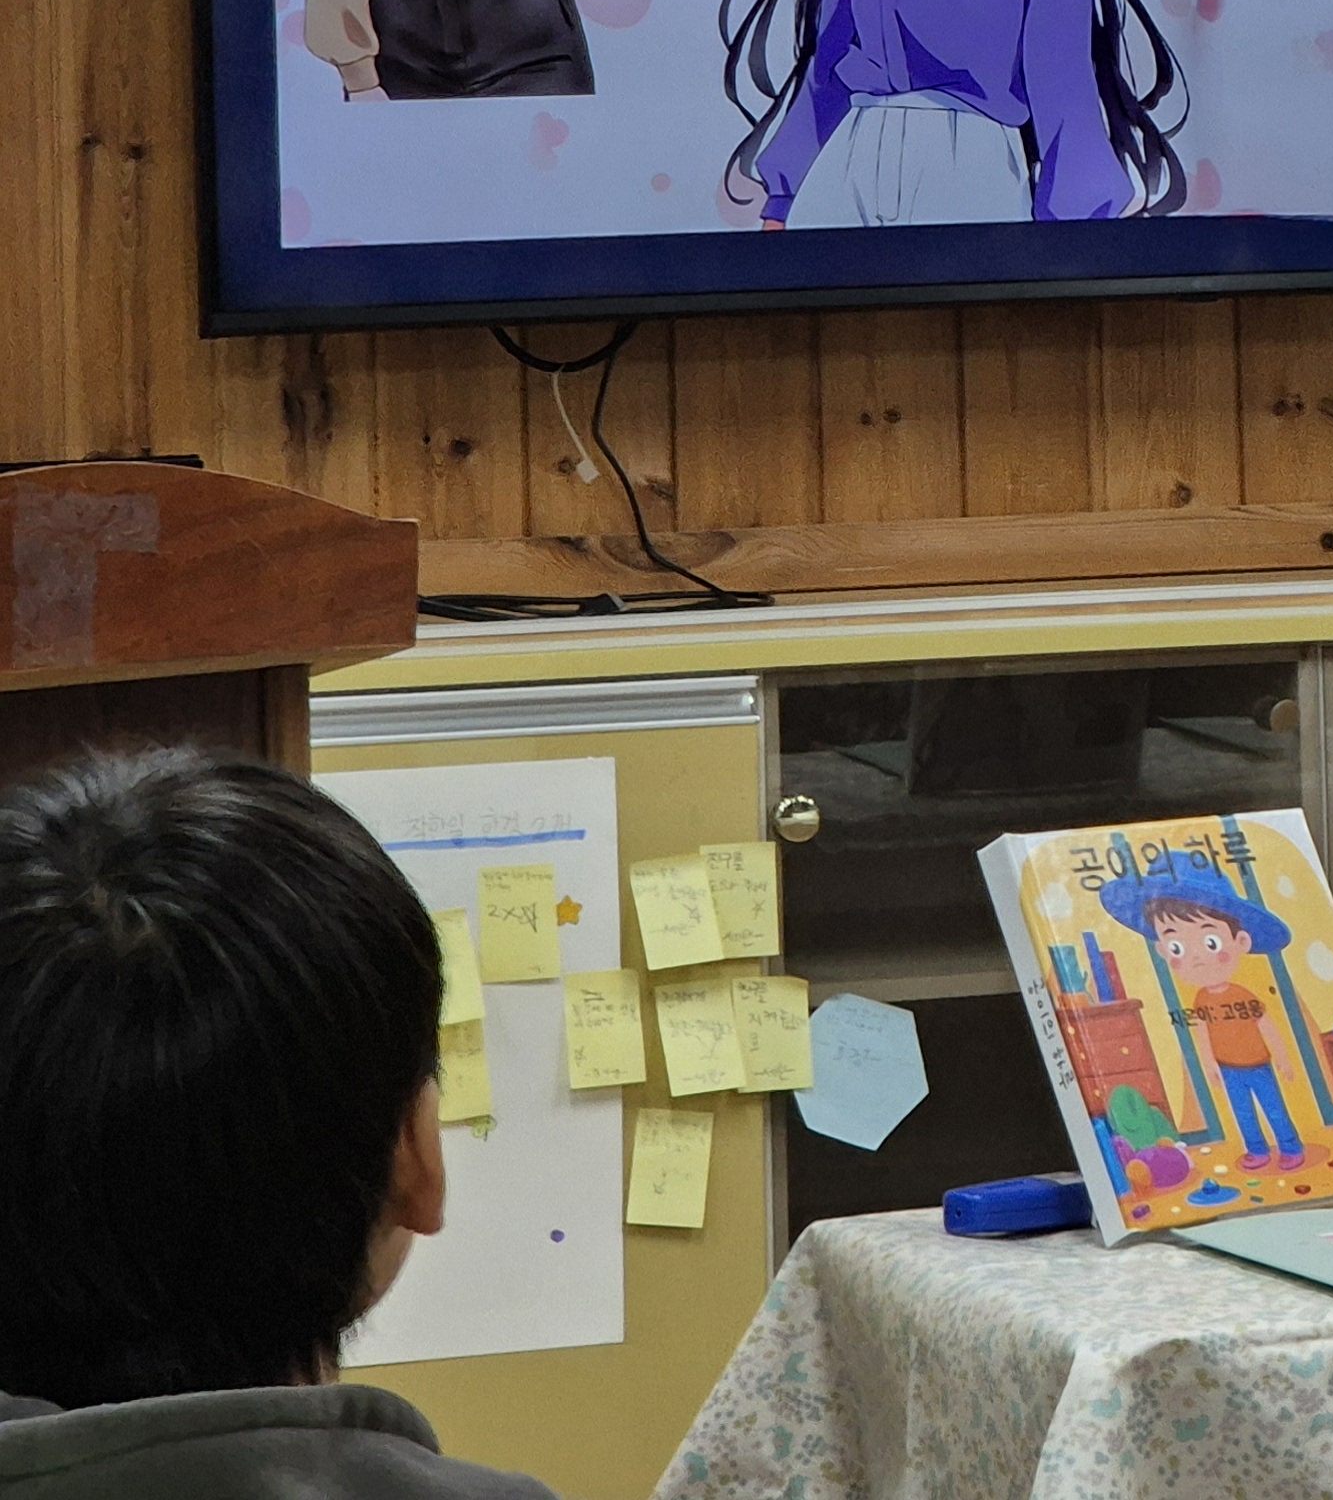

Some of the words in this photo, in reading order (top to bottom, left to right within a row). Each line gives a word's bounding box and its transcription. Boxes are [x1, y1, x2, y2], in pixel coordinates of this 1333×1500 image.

[1068, 837, 1180, 893] 공이의
[1183, 830, 1257, 879] 하루
[1168, 1005, 1218, 1029] 지은이:
